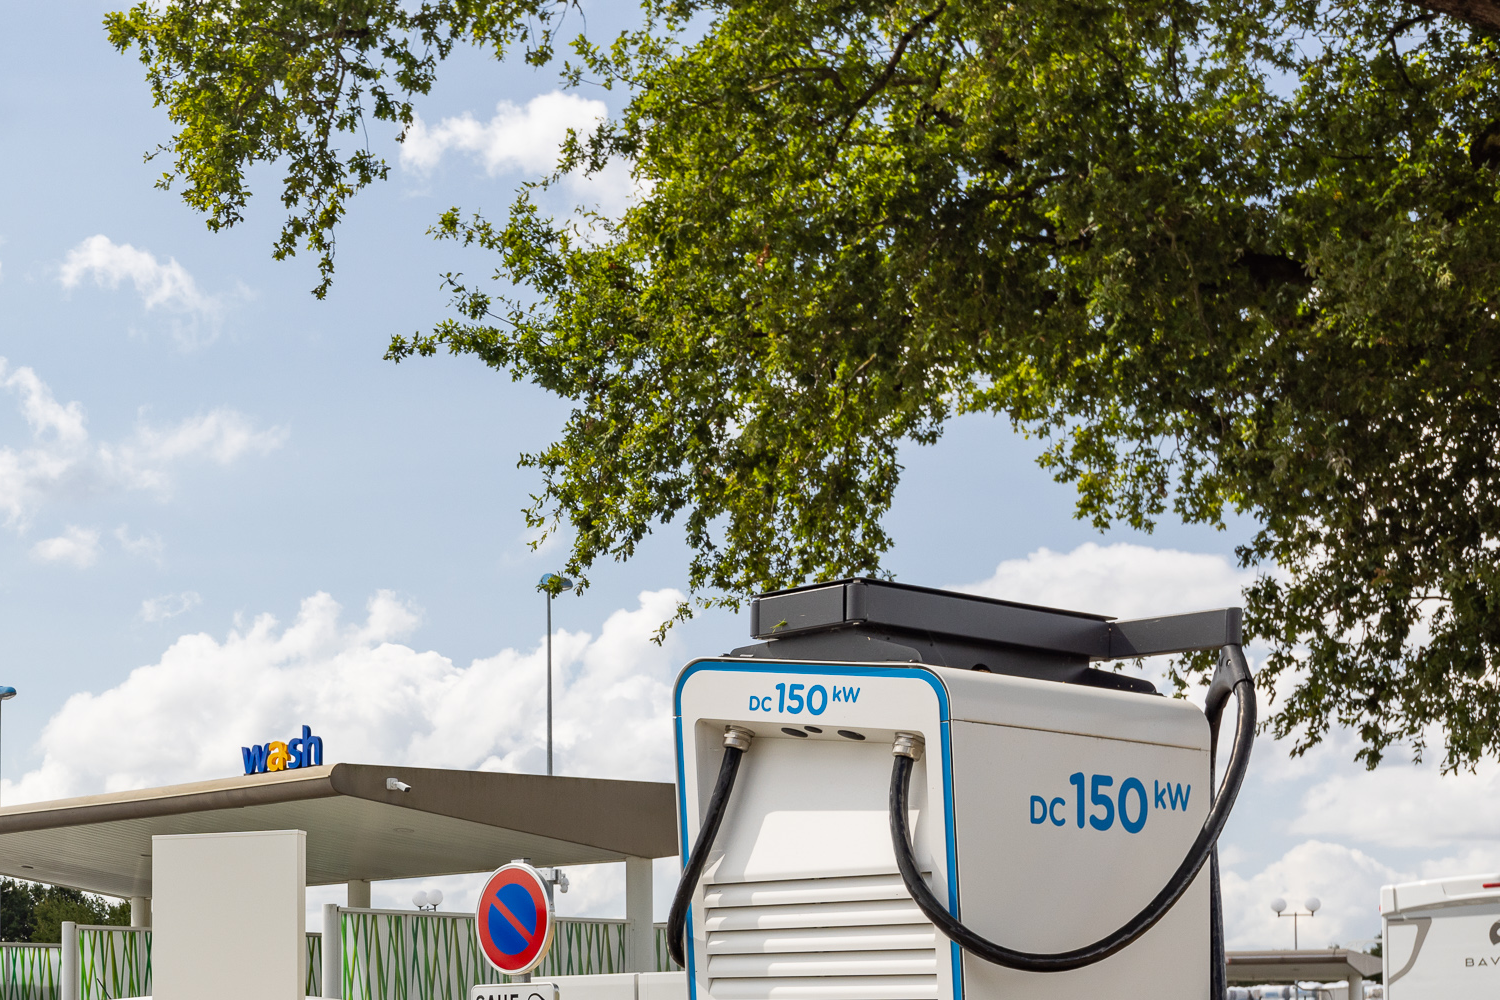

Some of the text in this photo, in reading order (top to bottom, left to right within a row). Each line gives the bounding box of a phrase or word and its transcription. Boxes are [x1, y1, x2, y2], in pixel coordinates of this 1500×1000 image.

[749, 683, 860, 716] DC 150 kW
[241, 725, 323, 775] wash
[1030, 772, 1191, 834] DC 150 kW
[1465, 956, 1500, 967] BAV
